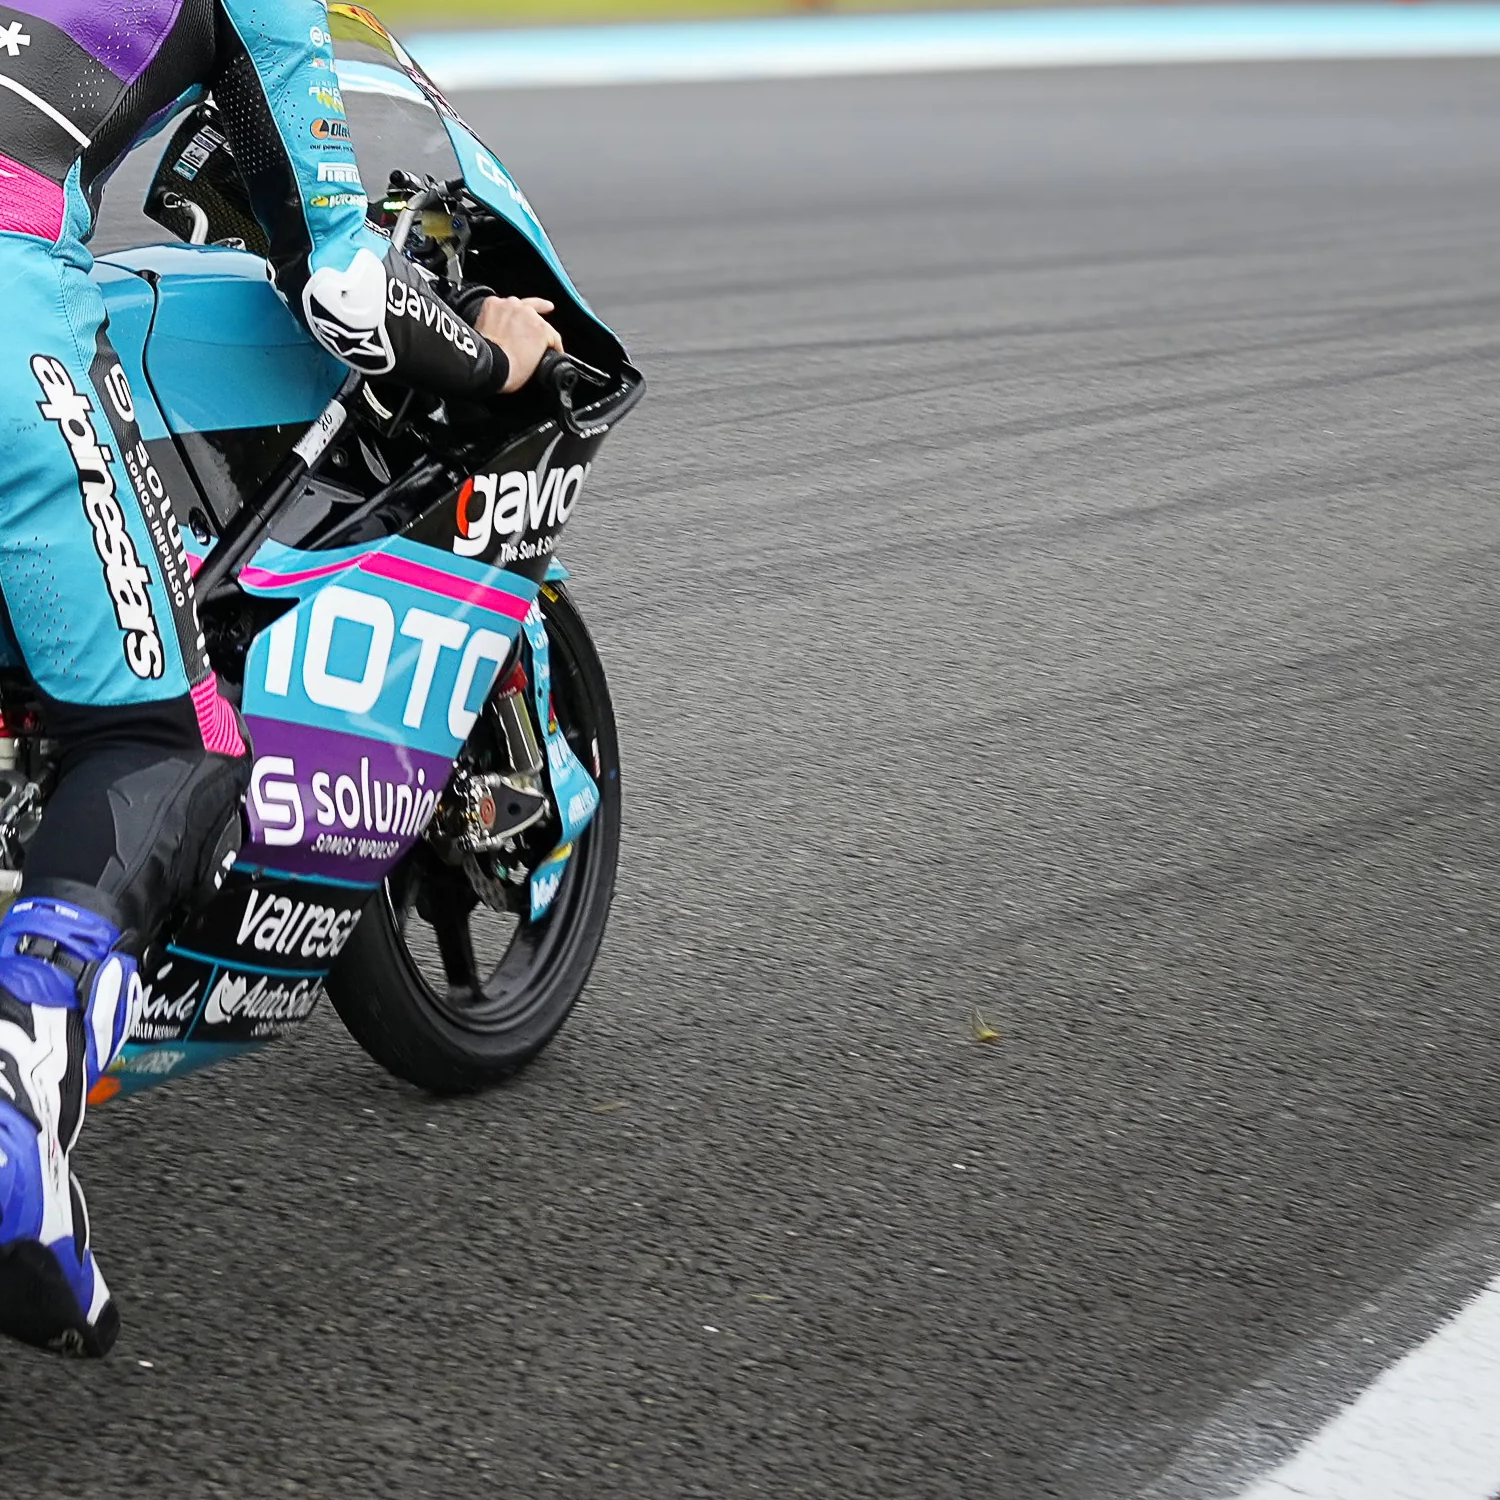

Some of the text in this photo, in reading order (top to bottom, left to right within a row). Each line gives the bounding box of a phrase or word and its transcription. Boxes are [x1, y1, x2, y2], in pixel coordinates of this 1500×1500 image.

[386, 277, 478, 359] gaviota
[30, 353, 165, 680] alpinestars
[125, 450, 185, 608] SOMOS IMPULSO
[452, 461, 592, 557] gavio
[236, 888, 362, 959] valresa
